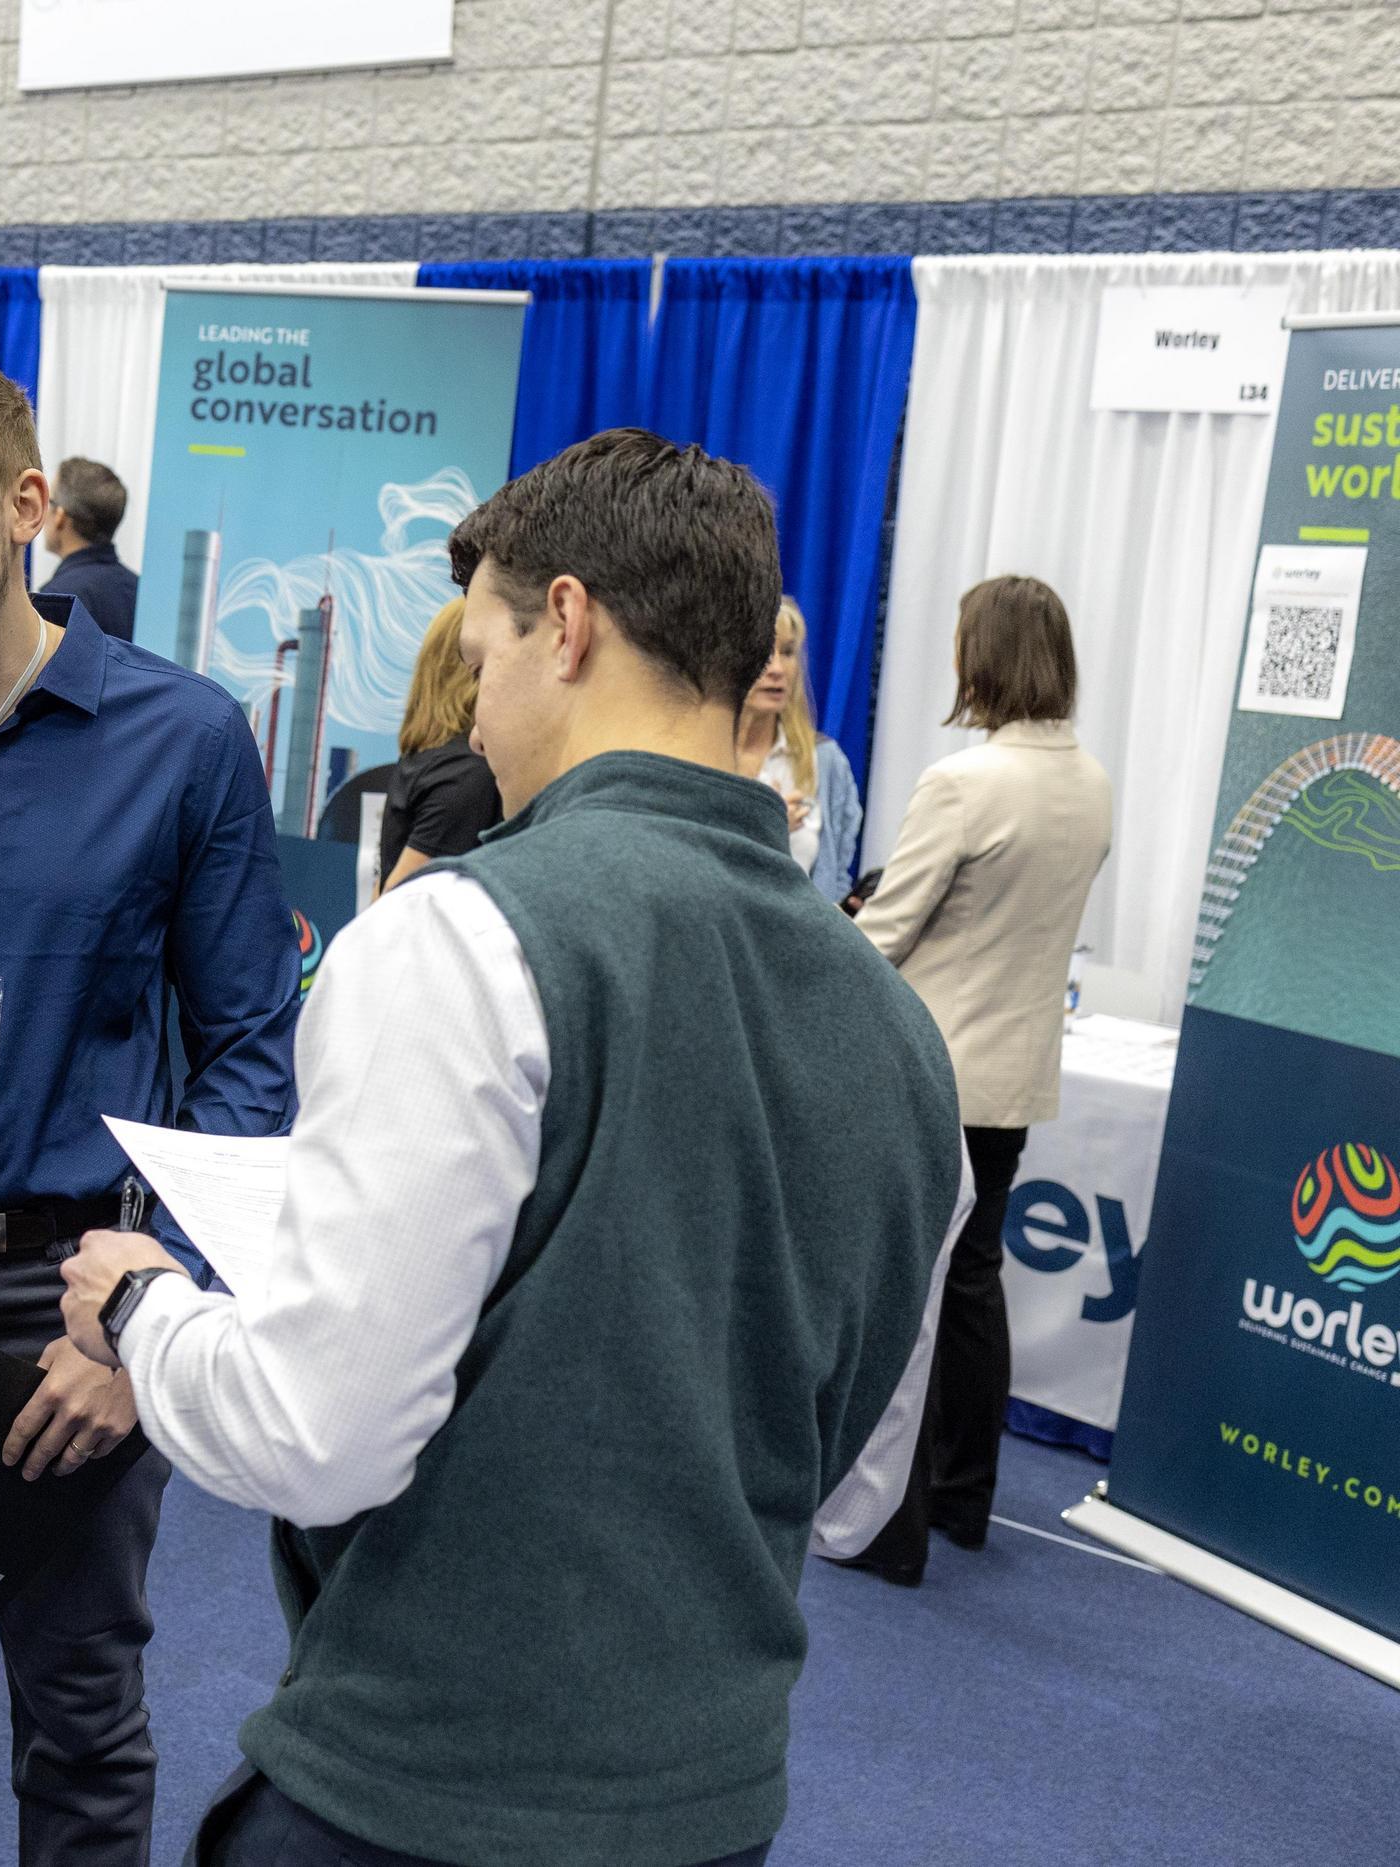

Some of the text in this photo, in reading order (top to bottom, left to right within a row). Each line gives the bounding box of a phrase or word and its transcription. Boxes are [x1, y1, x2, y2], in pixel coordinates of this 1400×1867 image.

[198, 325, 310, 346] LEADING THE
[1155, 329, 1221, 350] Worley
[192, 350, 312, 392] global
[1323, 368, 1400, 391] DELIVER
[191, 397, 437, 436] conversation
[1311, 404, 1400, 447] sust
[1306, 452, 1400, 500] worl
[1238, 1318, 1388, 1383] DELIVERING SUSTAINABLE CHANGE
[1243, 1278, 1400, 1386] worle
[1220, 1422, 1400, 1519] WORLEY.COM
